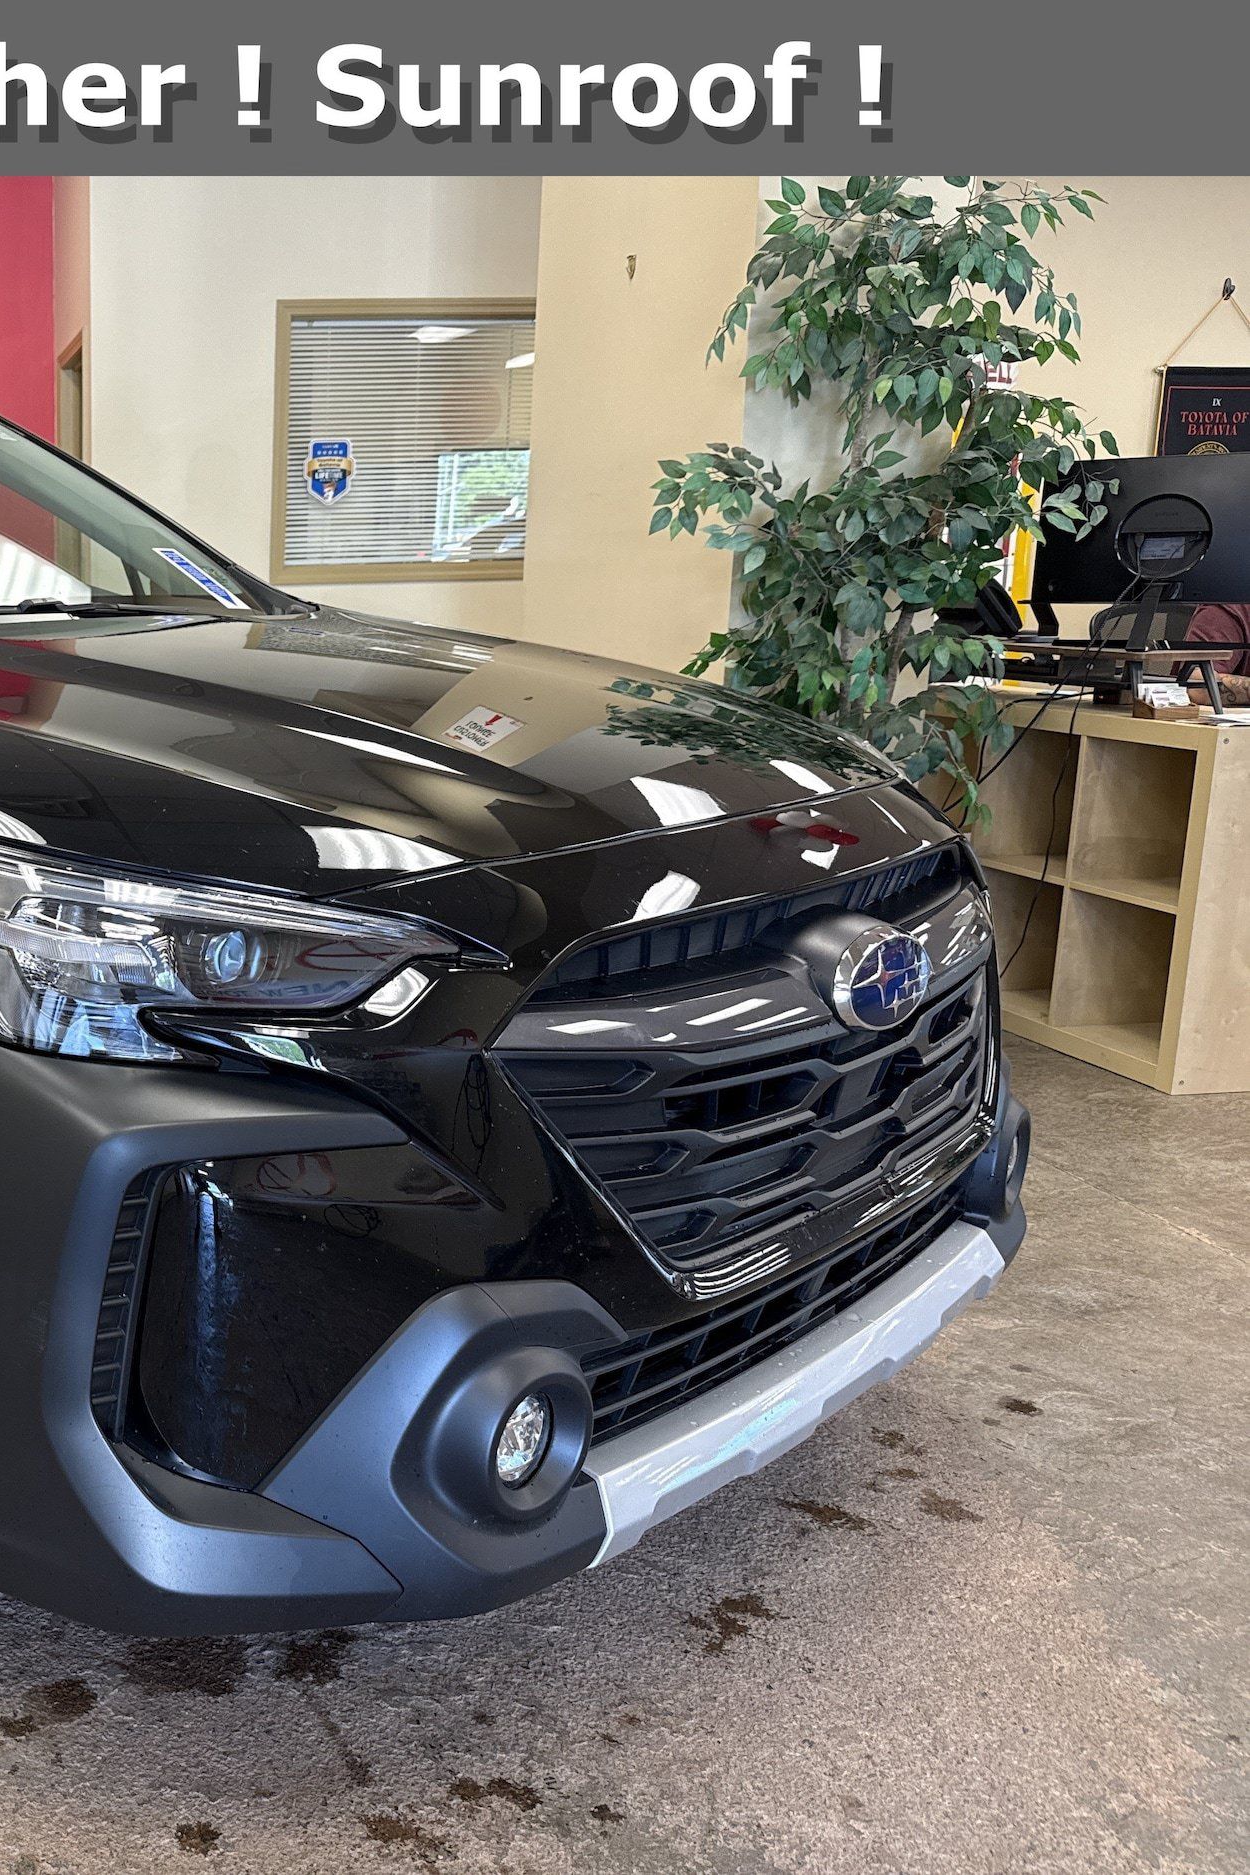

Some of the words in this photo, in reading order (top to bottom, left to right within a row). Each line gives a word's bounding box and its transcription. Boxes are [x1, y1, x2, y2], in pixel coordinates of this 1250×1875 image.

[1181, 411, 1227, 424] TOYOTA
[1232, 411, 1249, 424] OF
[1187, 424, 1237, 436] BATAVIA
